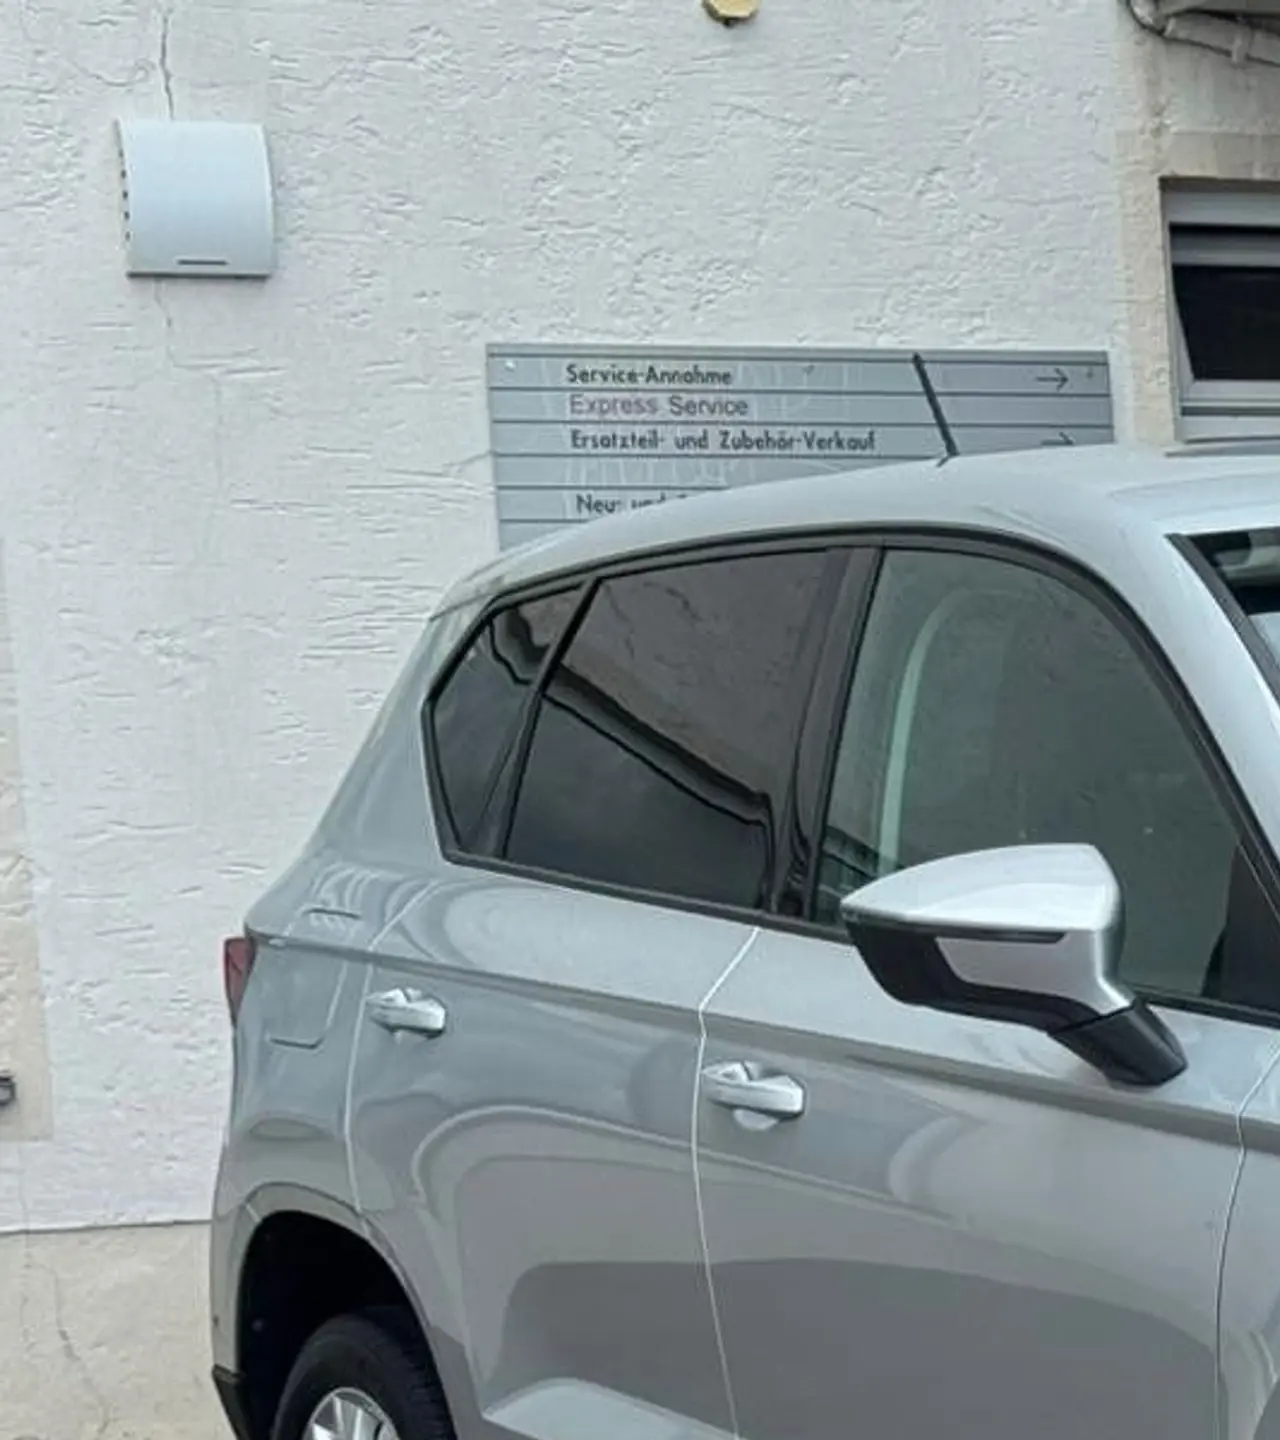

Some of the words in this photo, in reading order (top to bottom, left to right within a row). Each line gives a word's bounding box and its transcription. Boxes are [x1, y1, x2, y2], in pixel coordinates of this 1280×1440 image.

[566, 364, 733, 385] Service-Annahme
[569, 394, 660, 417] Express
[668, 394, 749, 417] Service
[674, 430, 710, 451] und
[719, 429, 877, 451] Zubehör-Verkauf
